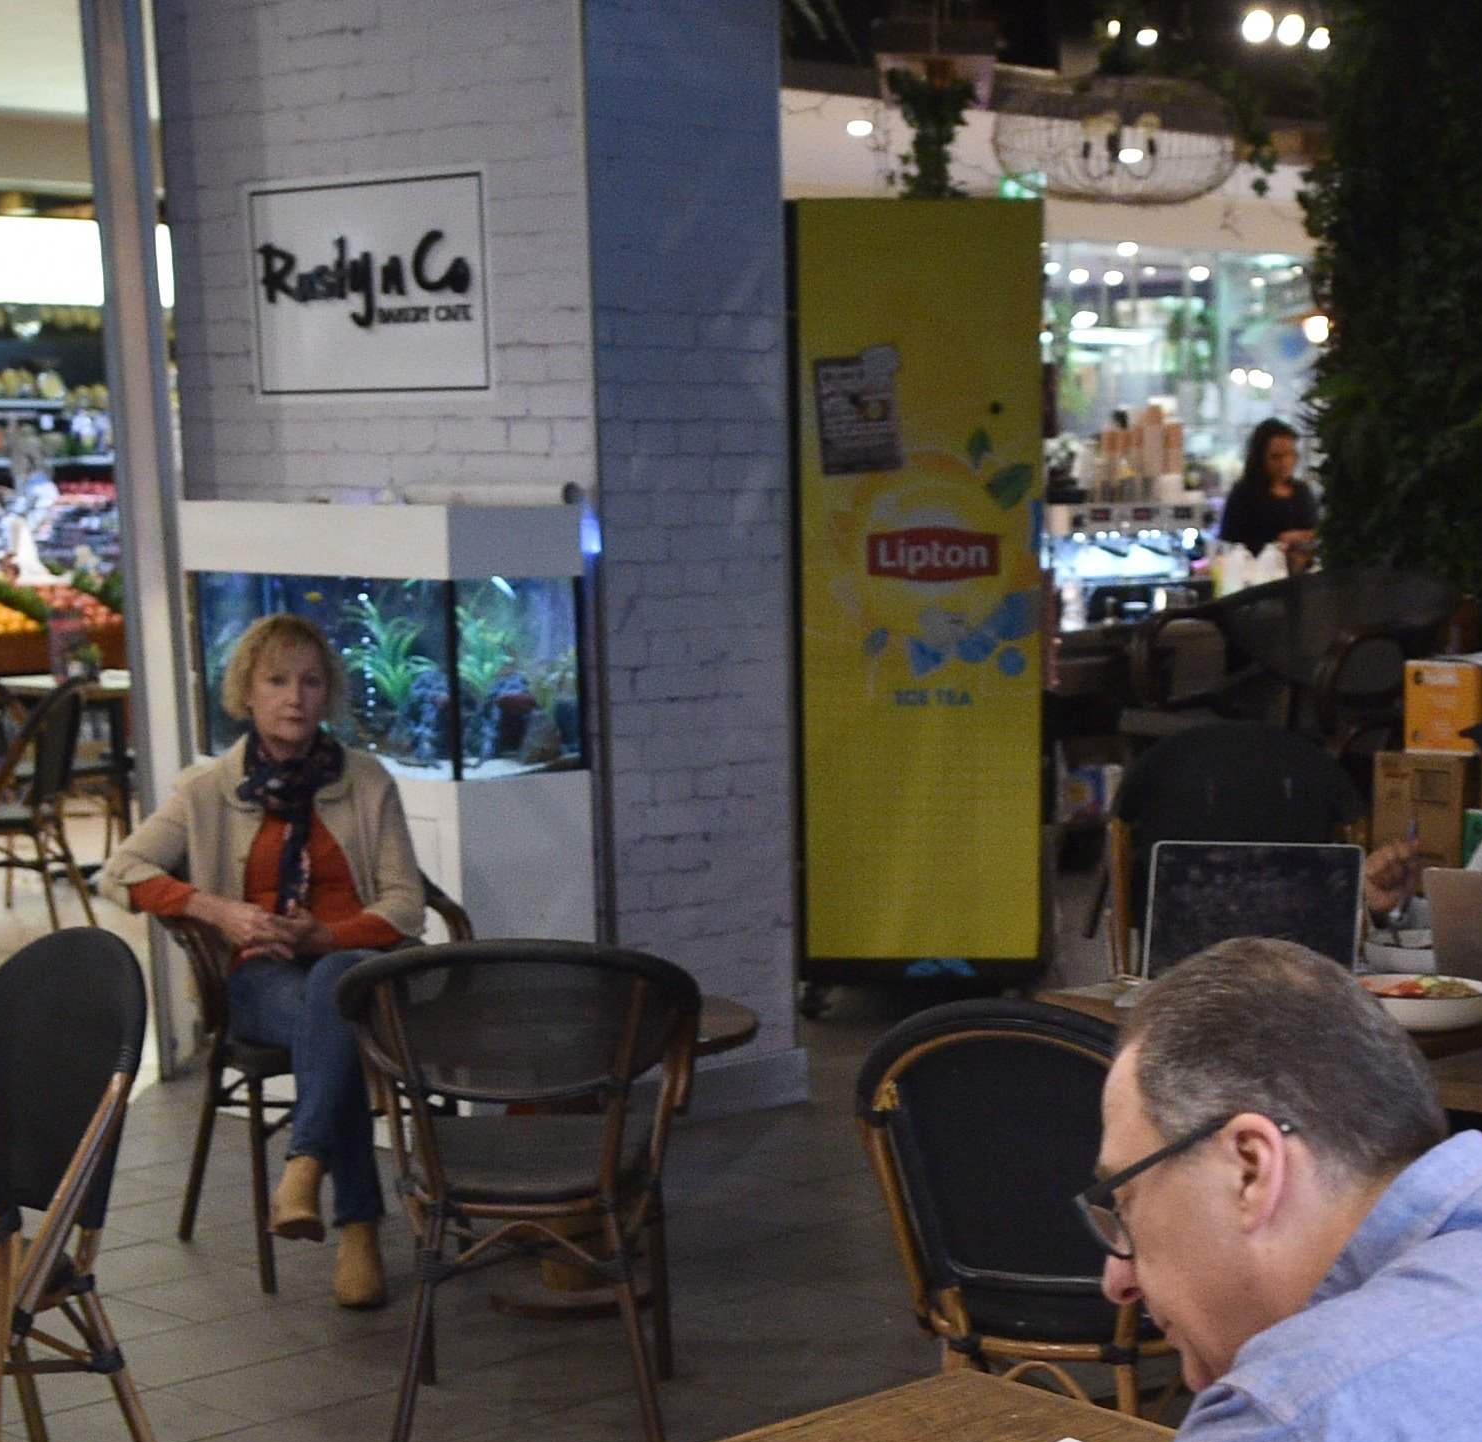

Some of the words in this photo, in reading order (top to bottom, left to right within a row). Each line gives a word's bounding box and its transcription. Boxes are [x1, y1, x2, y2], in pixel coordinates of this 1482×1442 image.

[412, 229, 471, 294] Co
[377, 306, 431, 324] BAKERY
[877, 538, 990, 575] Lipton
[934, 689, 974, 706] TEA
